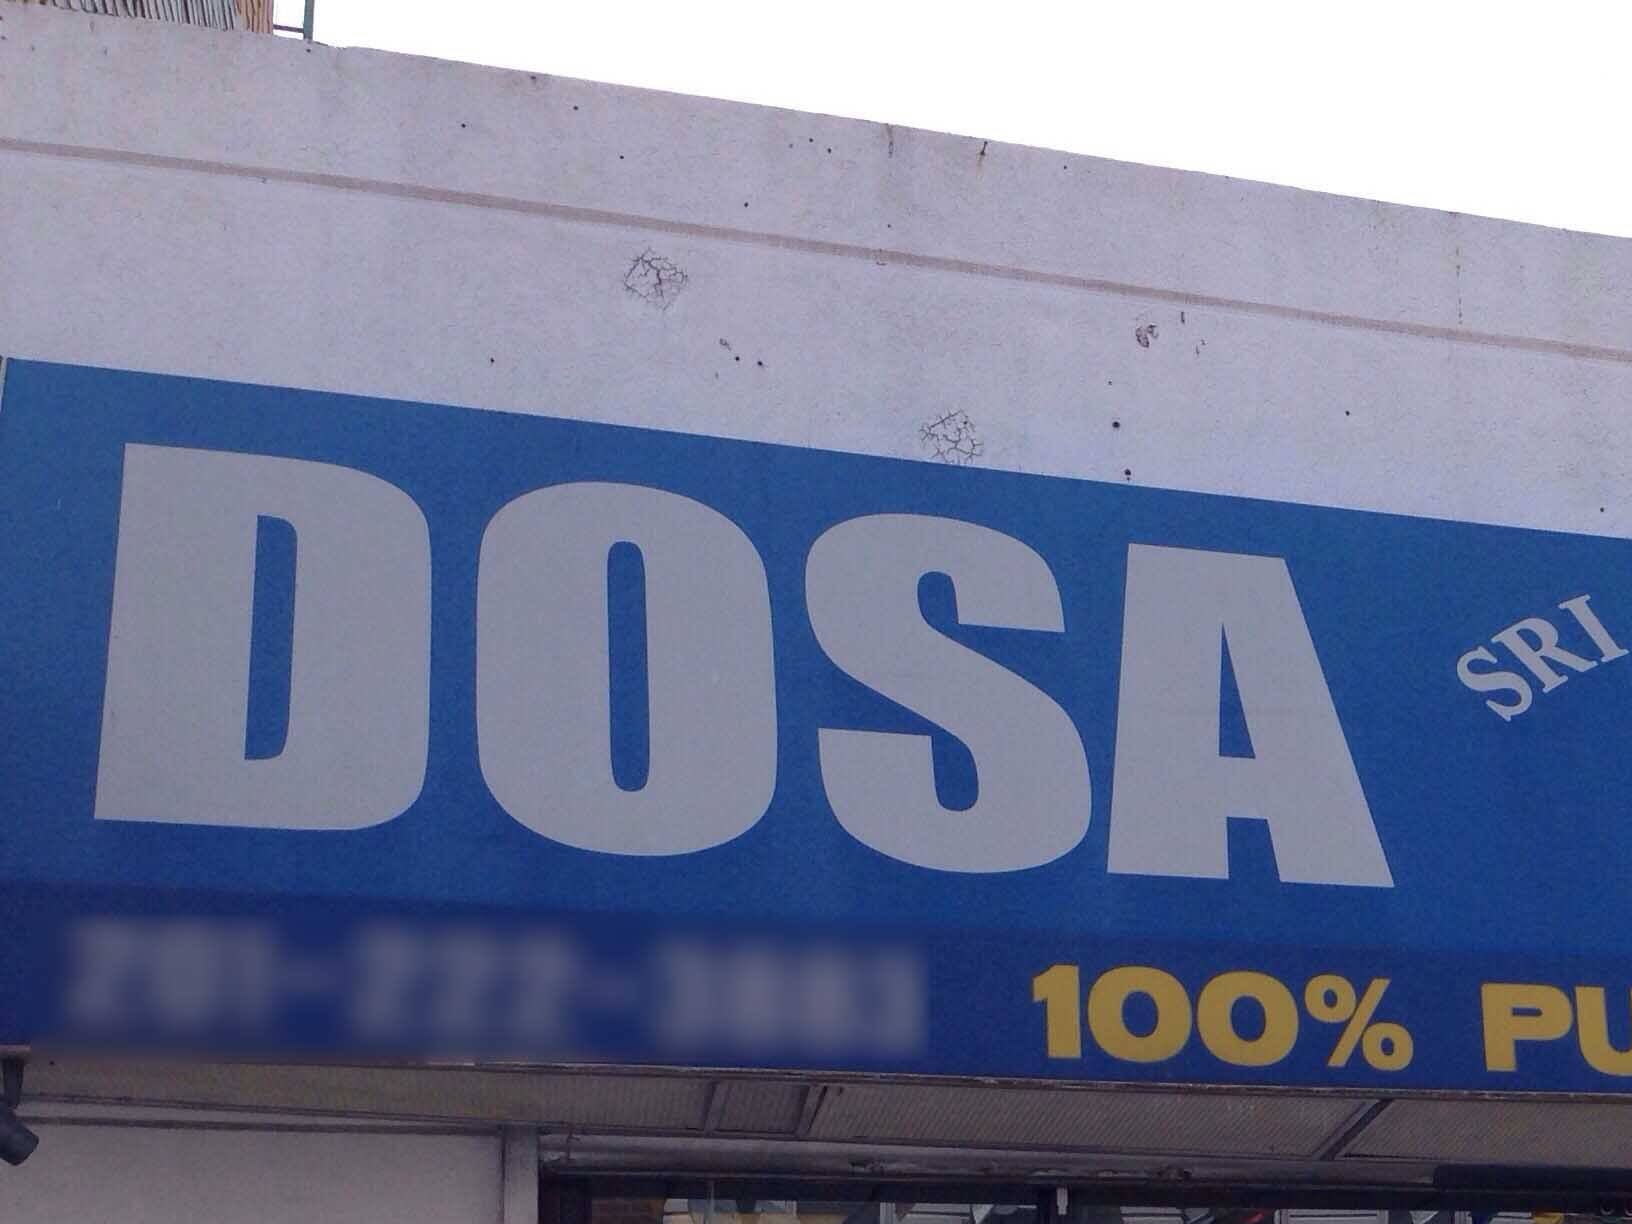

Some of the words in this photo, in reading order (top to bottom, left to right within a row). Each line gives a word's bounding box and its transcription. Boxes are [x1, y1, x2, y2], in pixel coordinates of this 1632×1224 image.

[94, 443, 1395, 887] DOSA
[1456, 594, 1629, 722] SRI
[1032, 964, 1414, 1072] 100%
